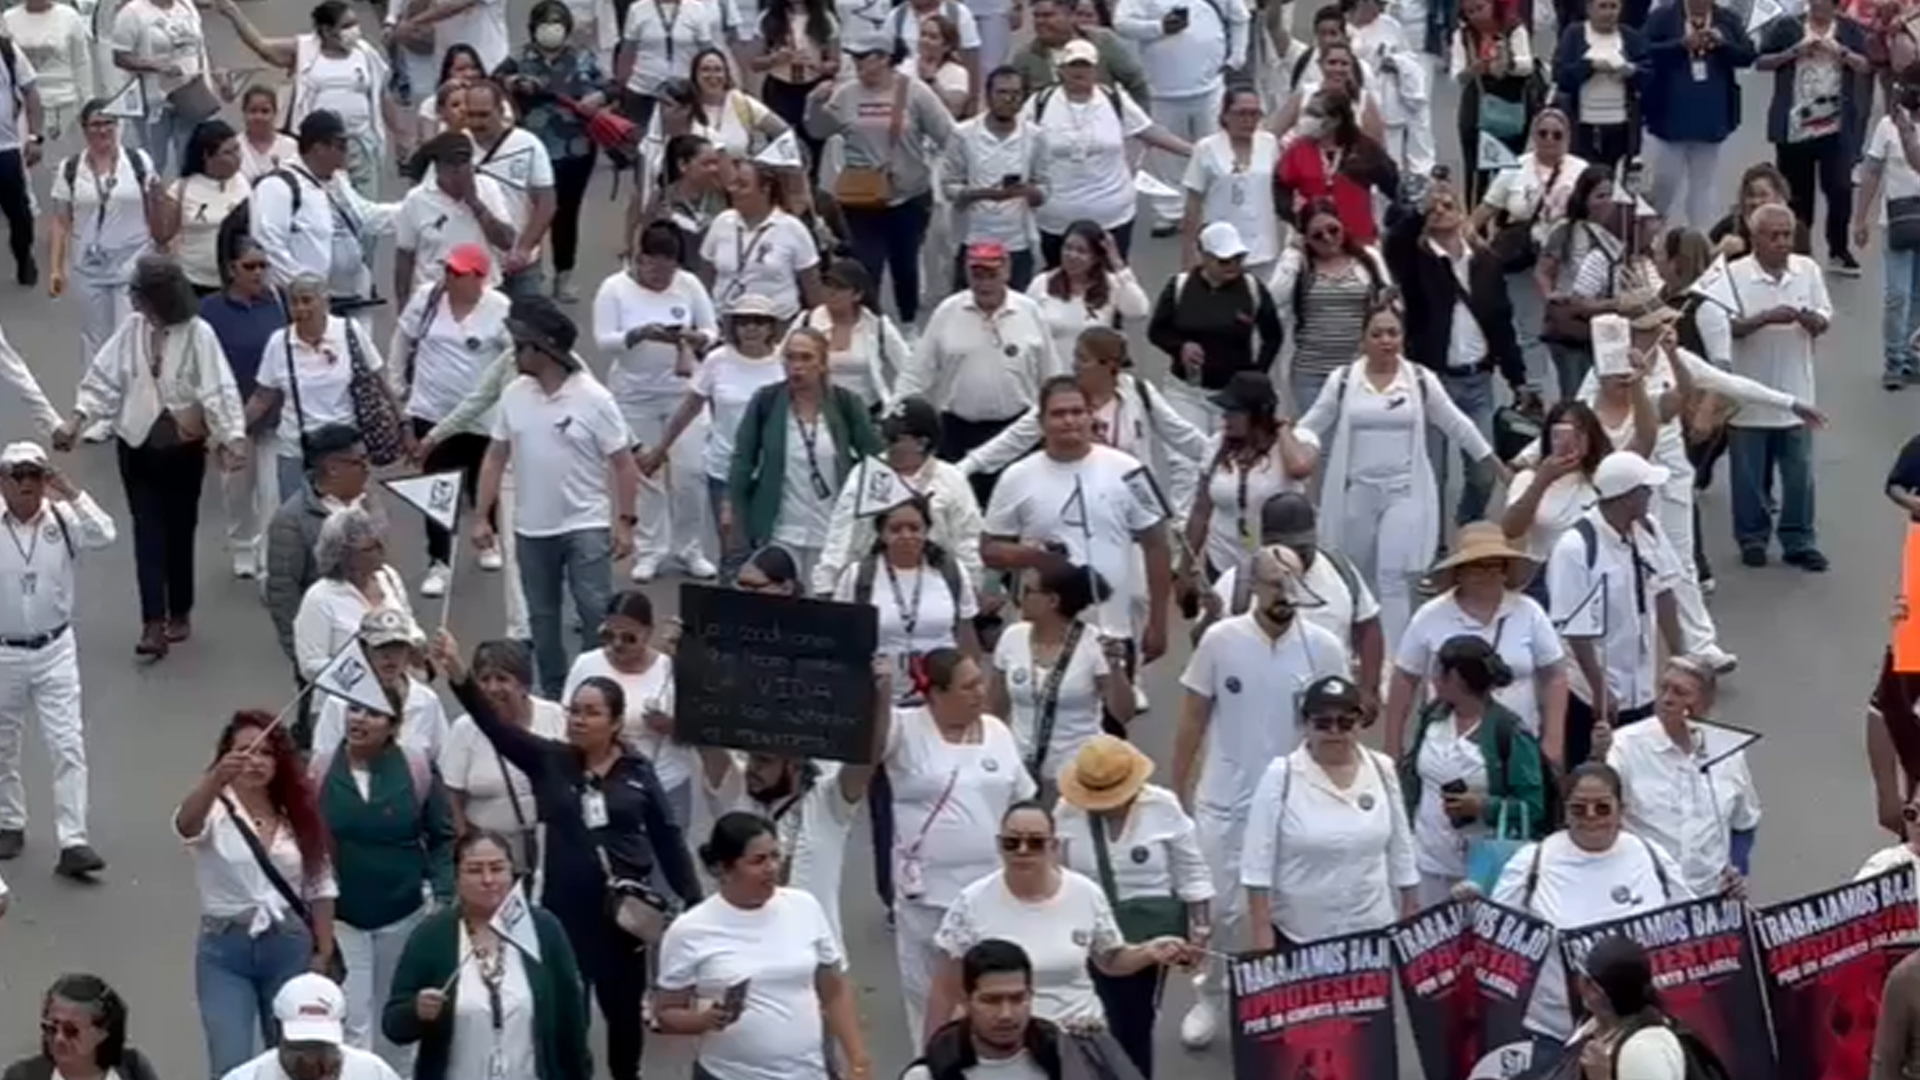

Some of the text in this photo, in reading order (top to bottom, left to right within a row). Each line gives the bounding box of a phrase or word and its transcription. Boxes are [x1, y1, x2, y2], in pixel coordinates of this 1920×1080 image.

[755, 676, 834, 700] VIDA
[1562, 900, 1742, 970] TRAAMOS BAJO
[1755, 869, 1915, 949] TRABAJAMOS BAJ
[1496, 914, 1550, 962] BAJO
[1232, 941, 1346, 996] TRABAJAMOS
